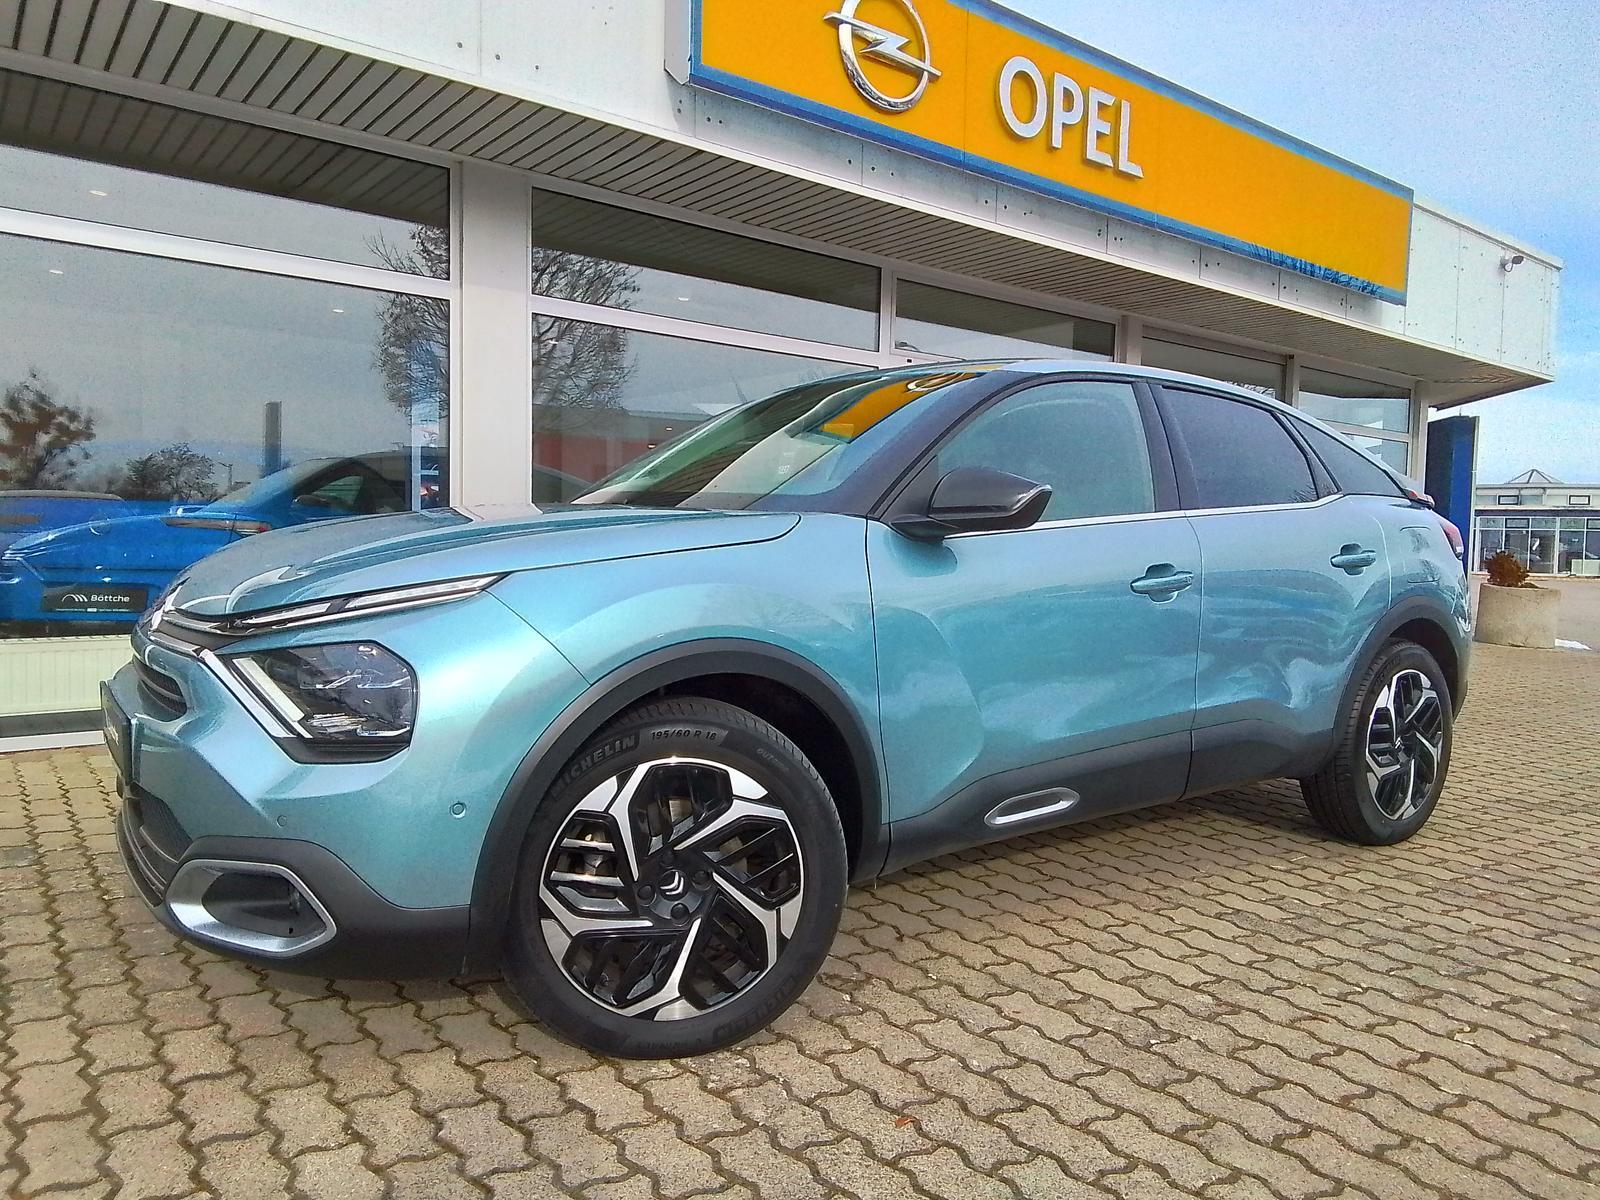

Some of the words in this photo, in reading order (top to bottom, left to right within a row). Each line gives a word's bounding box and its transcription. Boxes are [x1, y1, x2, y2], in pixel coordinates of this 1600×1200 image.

[999, 55, 1145, 178] OPEL
[90, 594, 130, 603] Böttche
[651, 729, 691, 741] 195/60
[694, 729, 702, 738] R
[551, 734, 636, 798] MICHELIN
